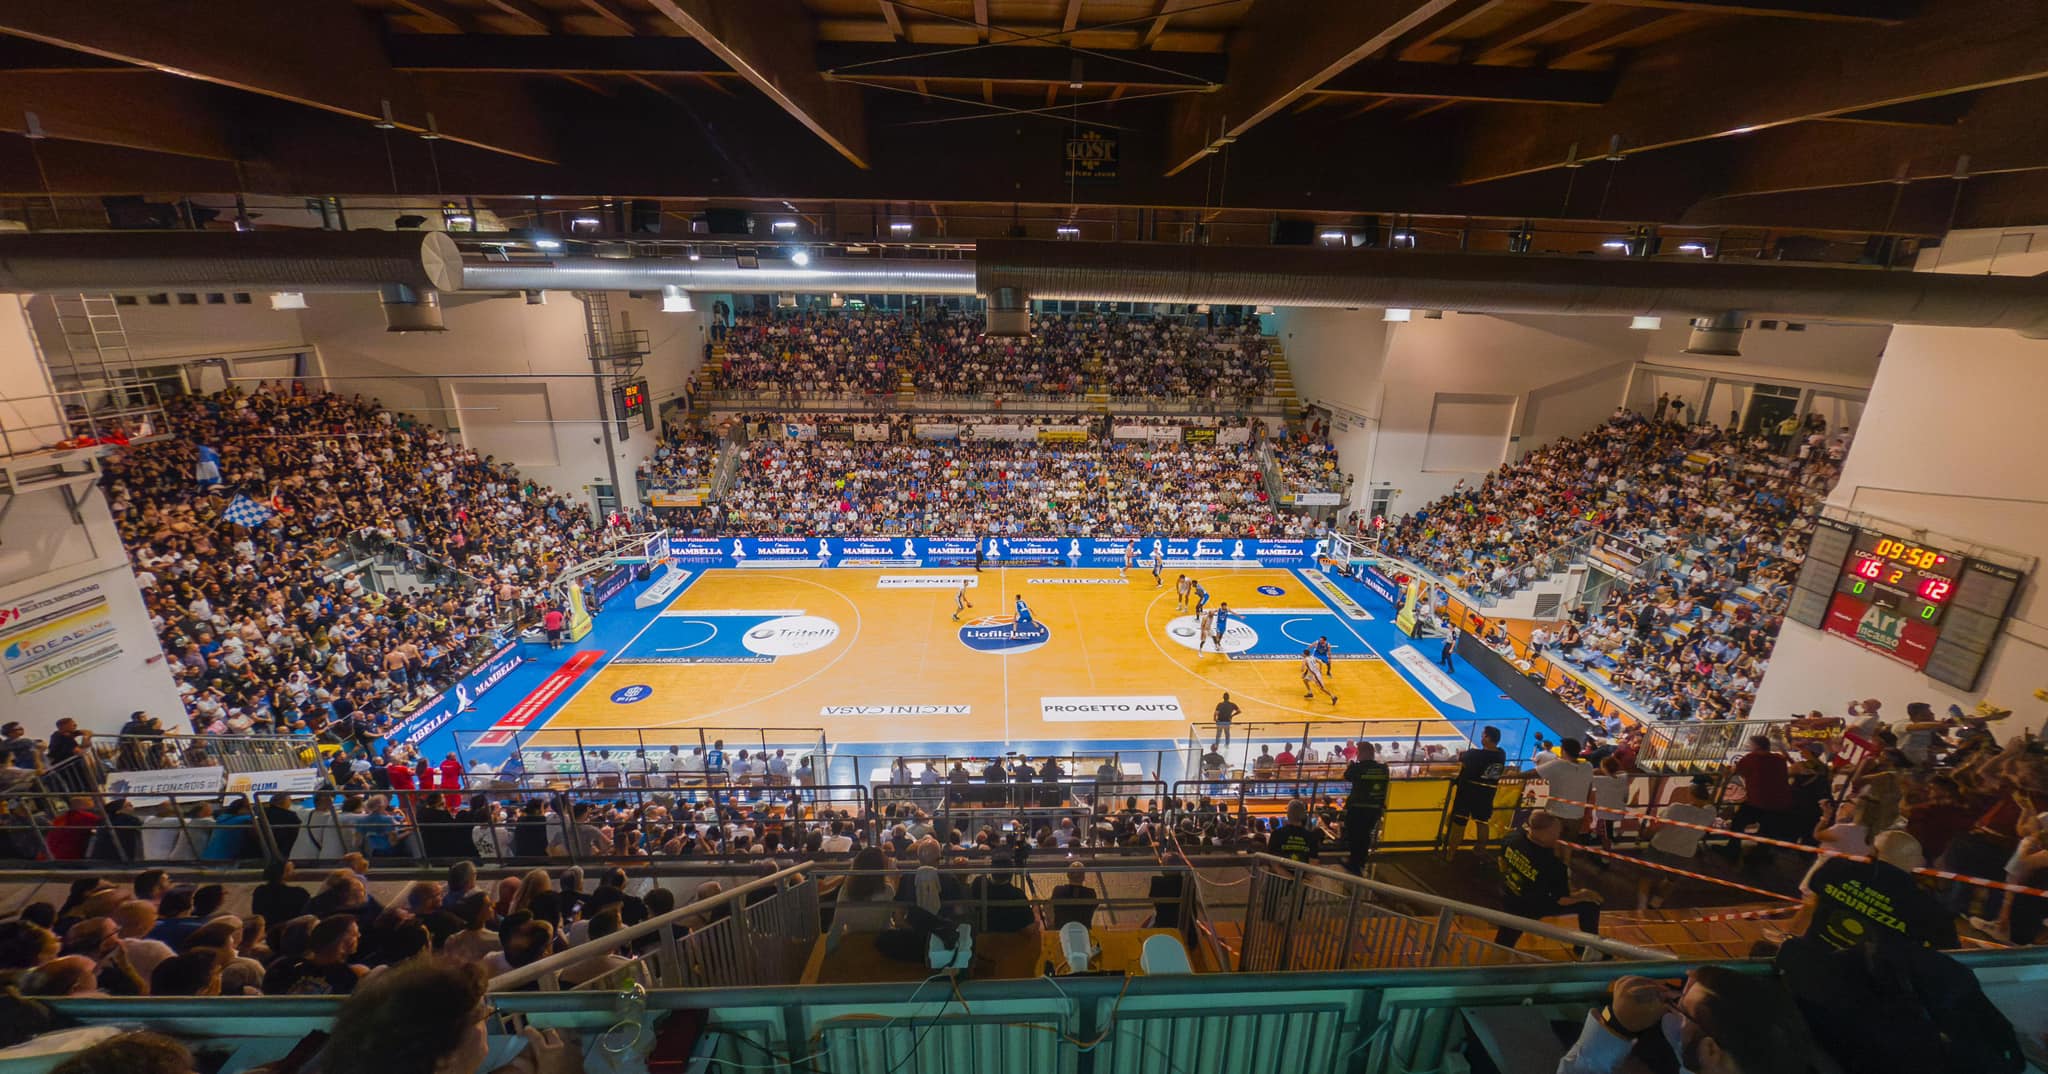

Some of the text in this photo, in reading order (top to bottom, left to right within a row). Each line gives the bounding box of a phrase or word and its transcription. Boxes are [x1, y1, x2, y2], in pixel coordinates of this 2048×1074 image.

[1876, 539, 1937, 570] 09:58
[1366, 576, 1393, 603] MAMBELLA
[1861, 560, 1882, 578] 16
[1890, 570, 1903, 584] 2
[1926, 581, 1949, 599] 12
[1853, 582, 1866, 594] 0
[1921, 606, 1936, 619] 0
[780, 628, 836, 637] Tritelli
[967, 630, 1040, 638] Liofilchem
[1864, 605, 1908, 638] Art
[475, 655, 523, 697] MAMBELLA
[384, 694, 445, 740] CASA FUNERARIA
[1044, 704, 1178, 712] PROGETTO AUTO
[406, 710, 453, 744] MBELLA
[1824, 883, 1907, 934] SICUREZZA
